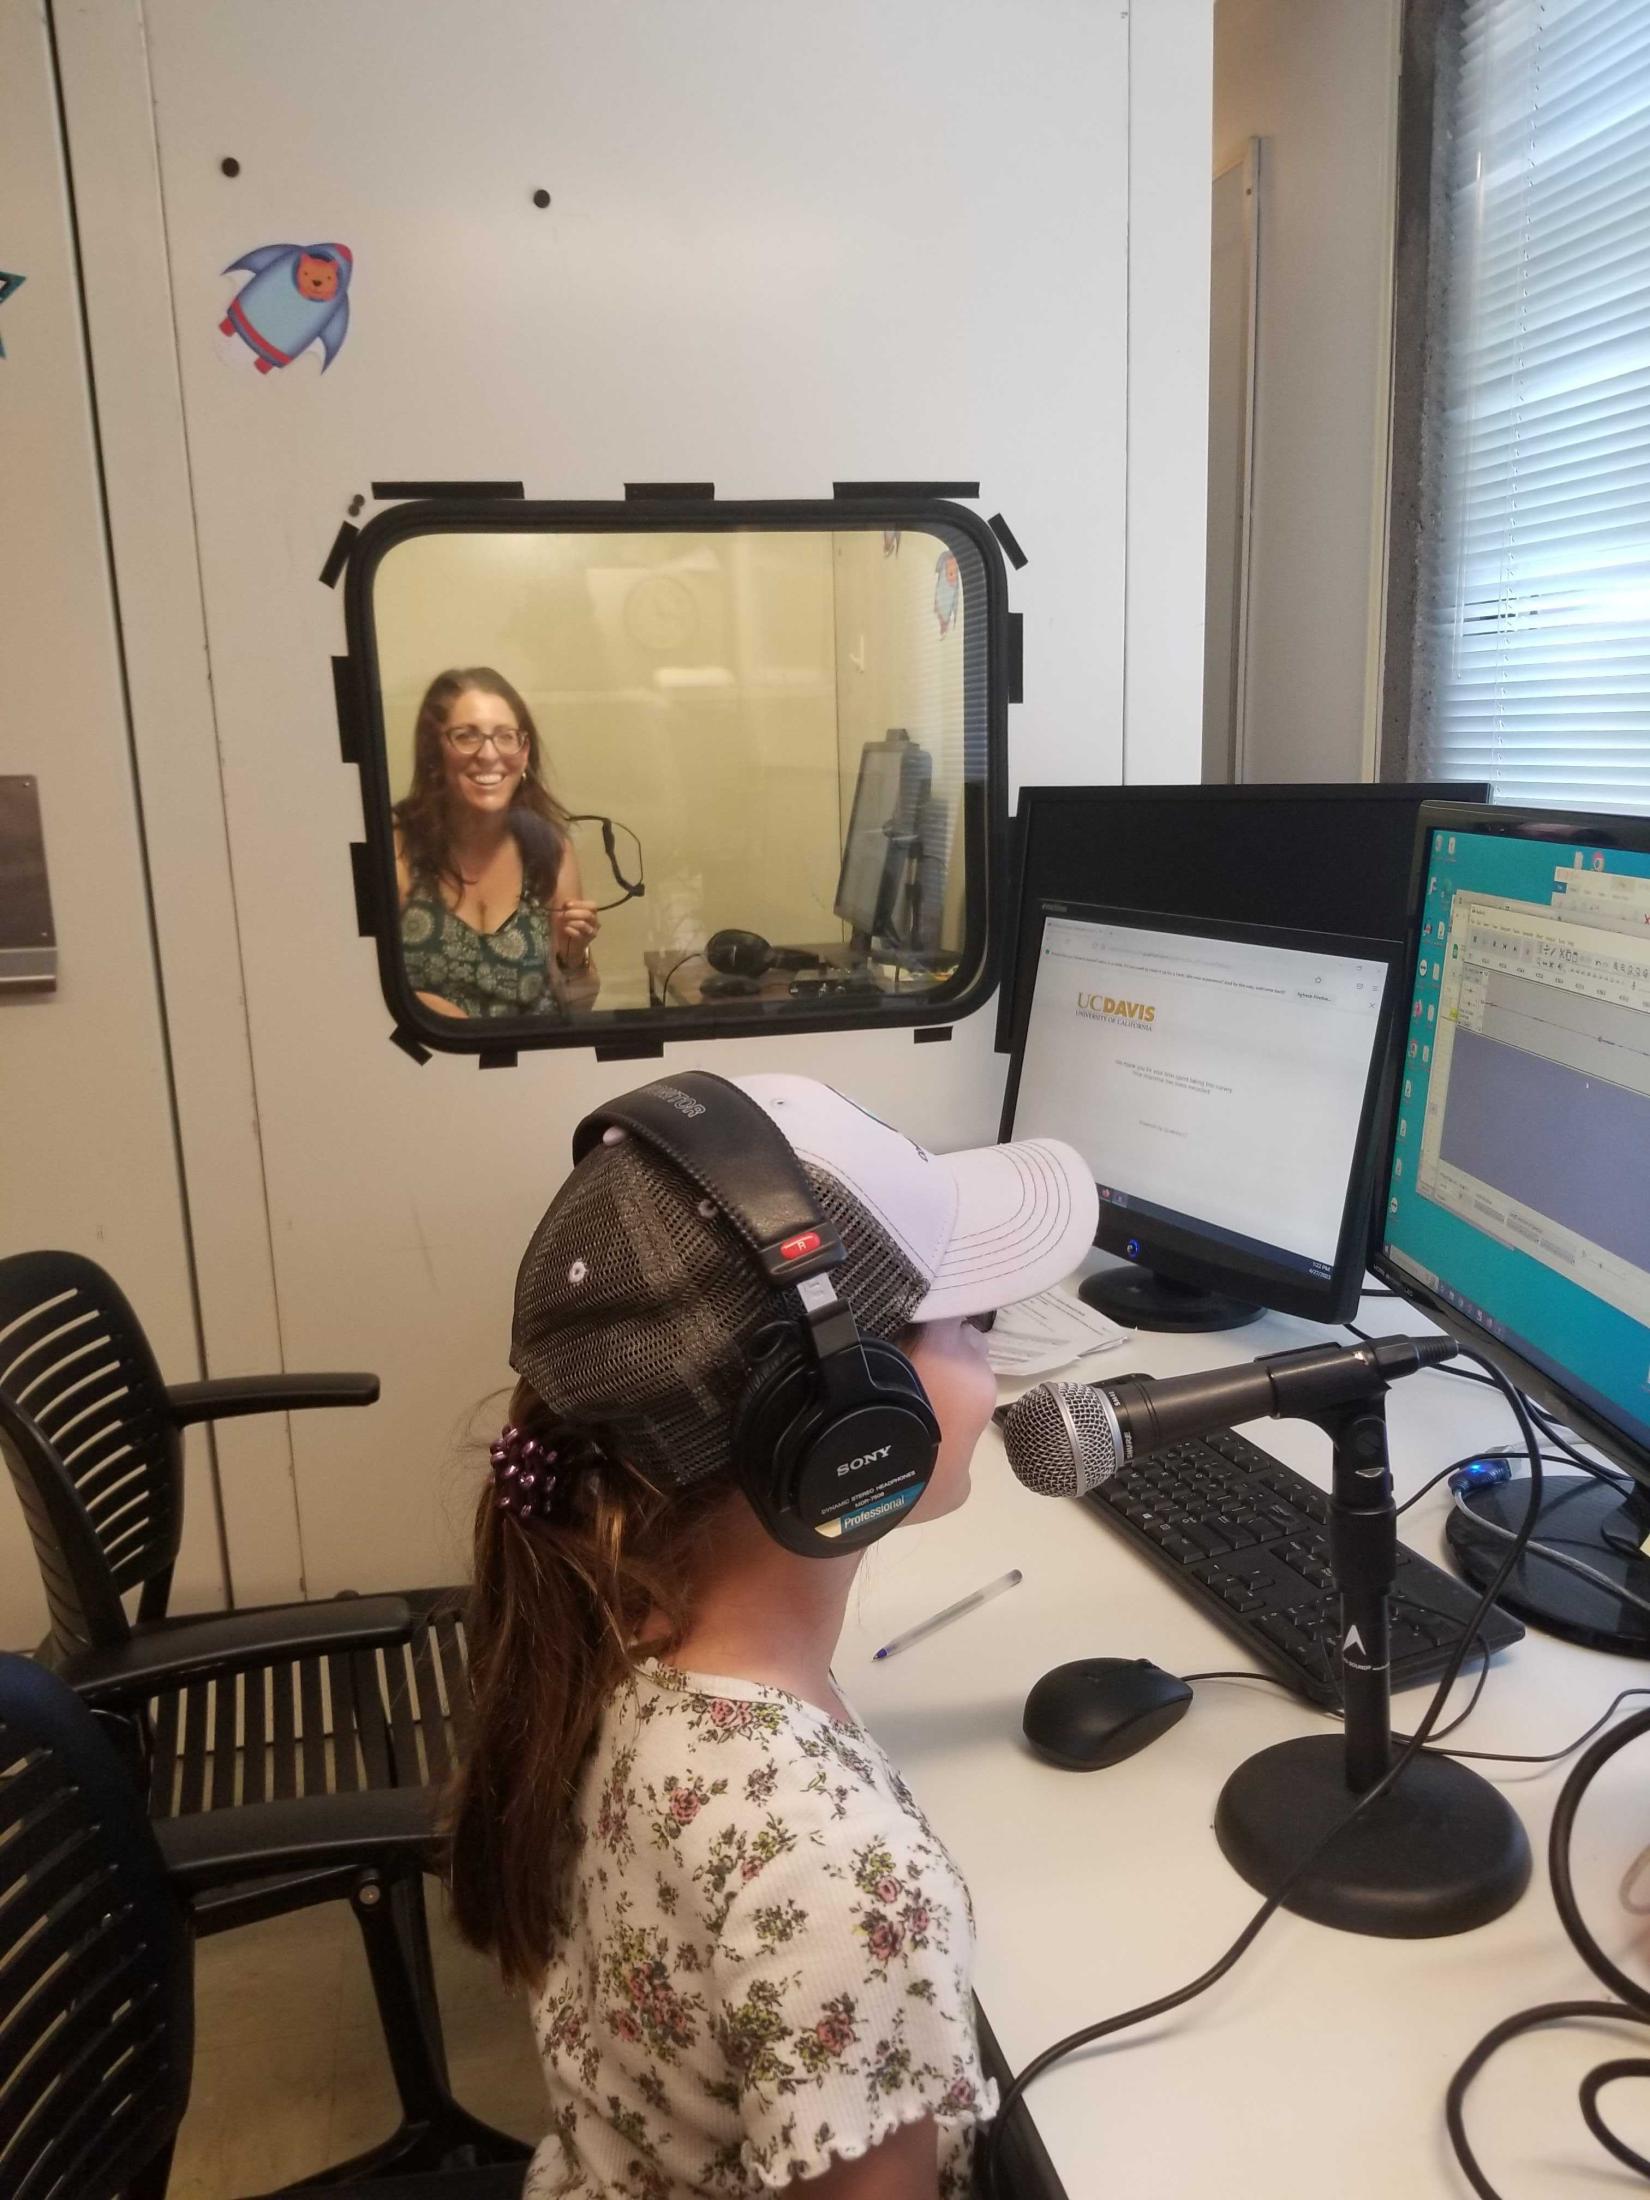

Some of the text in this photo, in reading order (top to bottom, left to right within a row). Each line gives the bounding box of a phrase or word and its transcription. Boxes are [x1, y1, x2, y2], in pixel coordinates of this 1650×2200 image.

[1076, 1009, 1152, 1032] UNIVERSITY OF CALIFORNIA
[837, 1445, 892, 1477] SONY
[1124, 1431, 1133, 1459] SHURE
[821, 1470, 917, 1515] DYNAMIC STEREO HEADPHONES
[844, 1495, 905, 1529] Professional
